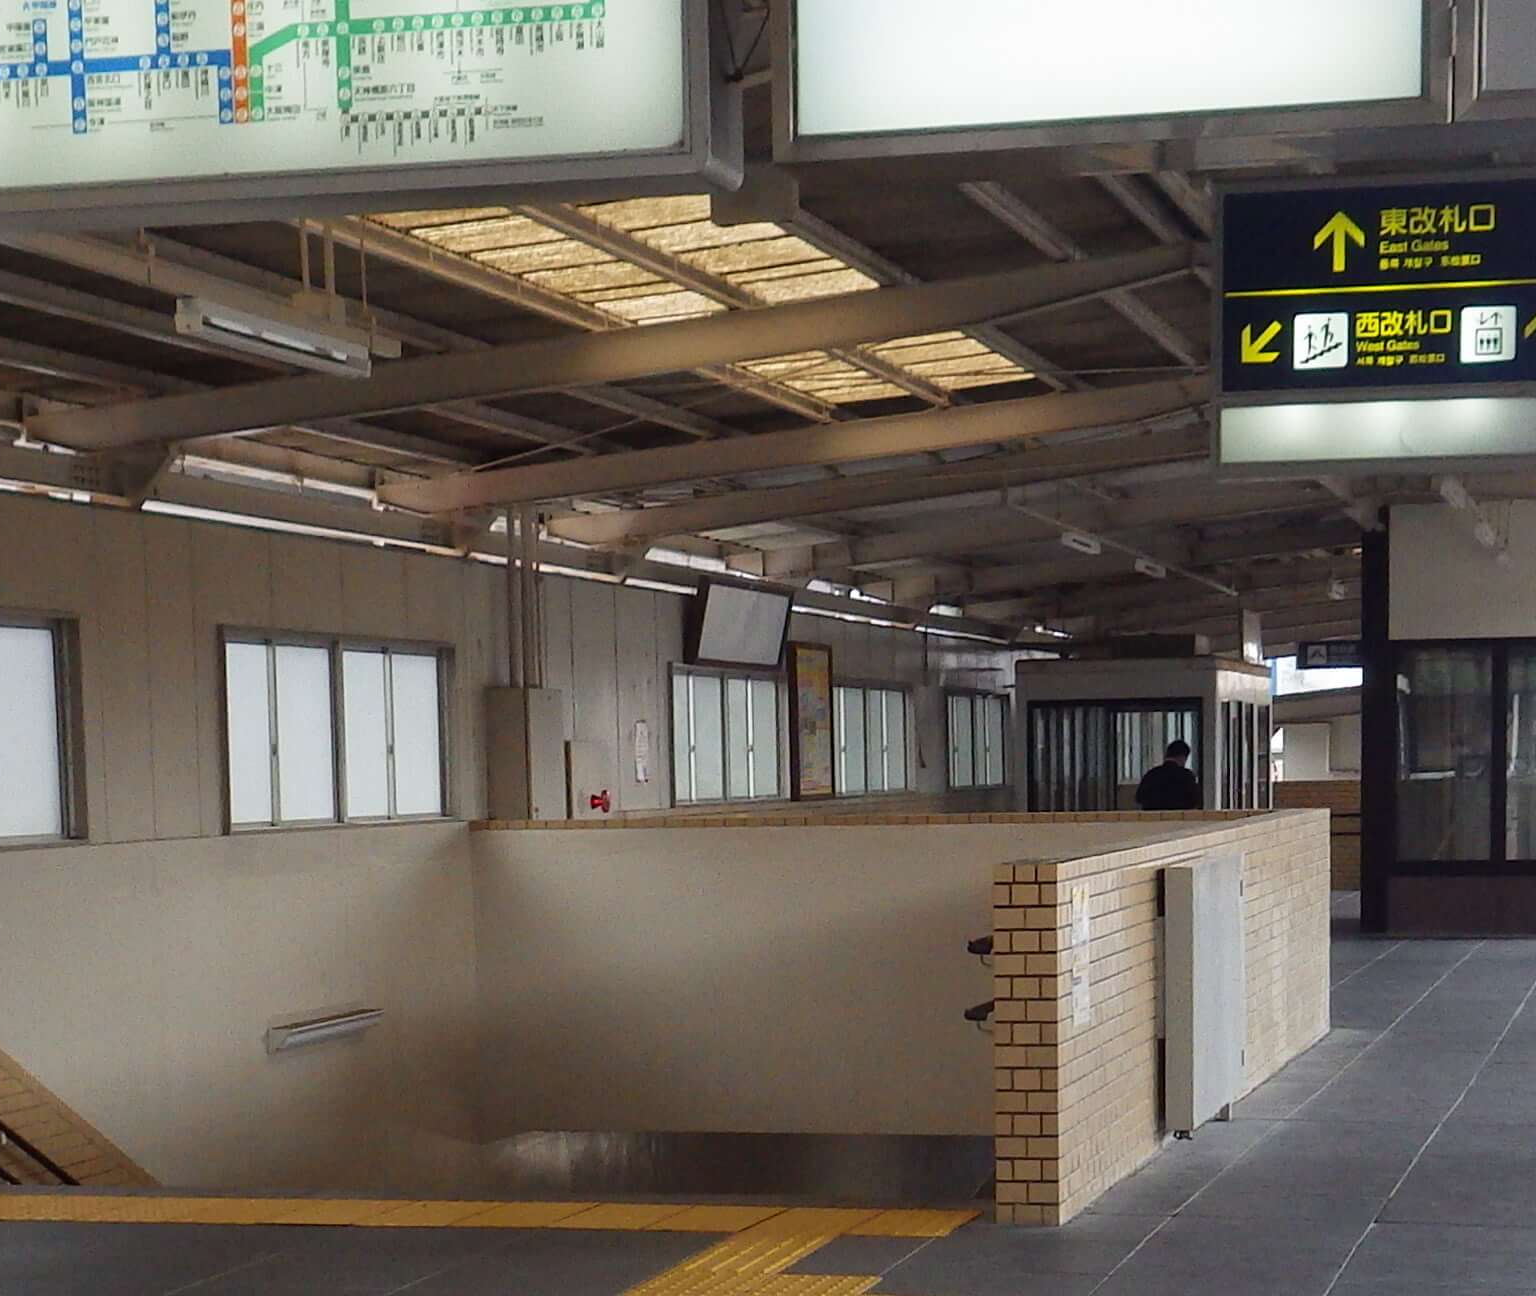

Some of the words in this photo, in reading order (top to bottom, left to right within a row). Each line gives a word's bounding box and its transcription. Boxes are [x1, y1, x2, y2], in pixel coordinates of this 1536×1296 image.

[1379, 204, 1495, 236] 東改札口
[1379, 241, 1408, 255] East
[1411, 239, 1449, 252] Gates
[1355, 310, 1452, 338] 西改札口
[1355, 340, 1385, 353] West
[1386, 339, 1421, 352] Gates
